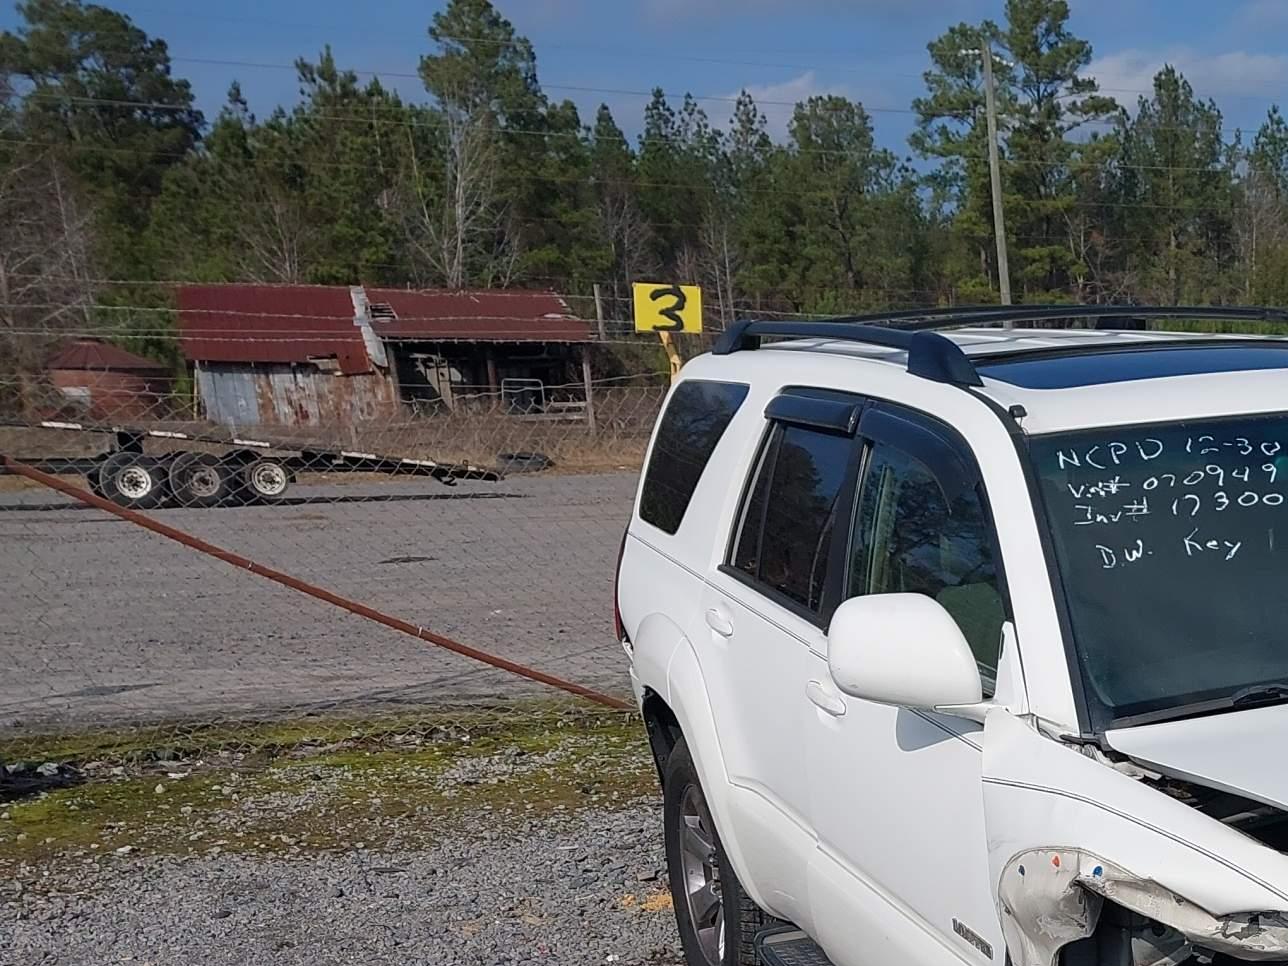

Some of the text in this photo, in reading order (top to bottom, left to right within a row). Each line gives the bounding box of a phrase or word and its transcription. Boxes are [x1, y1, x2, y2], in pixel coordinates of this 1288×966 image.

[650, 285, 686, 331] 3
[1057, 437, 1164, 469] NCPD
[1143, 463, 1277, 490] 070949
[1171, 491, 1284, 516] 17300
[1184, 528, 1242, 560] Key
